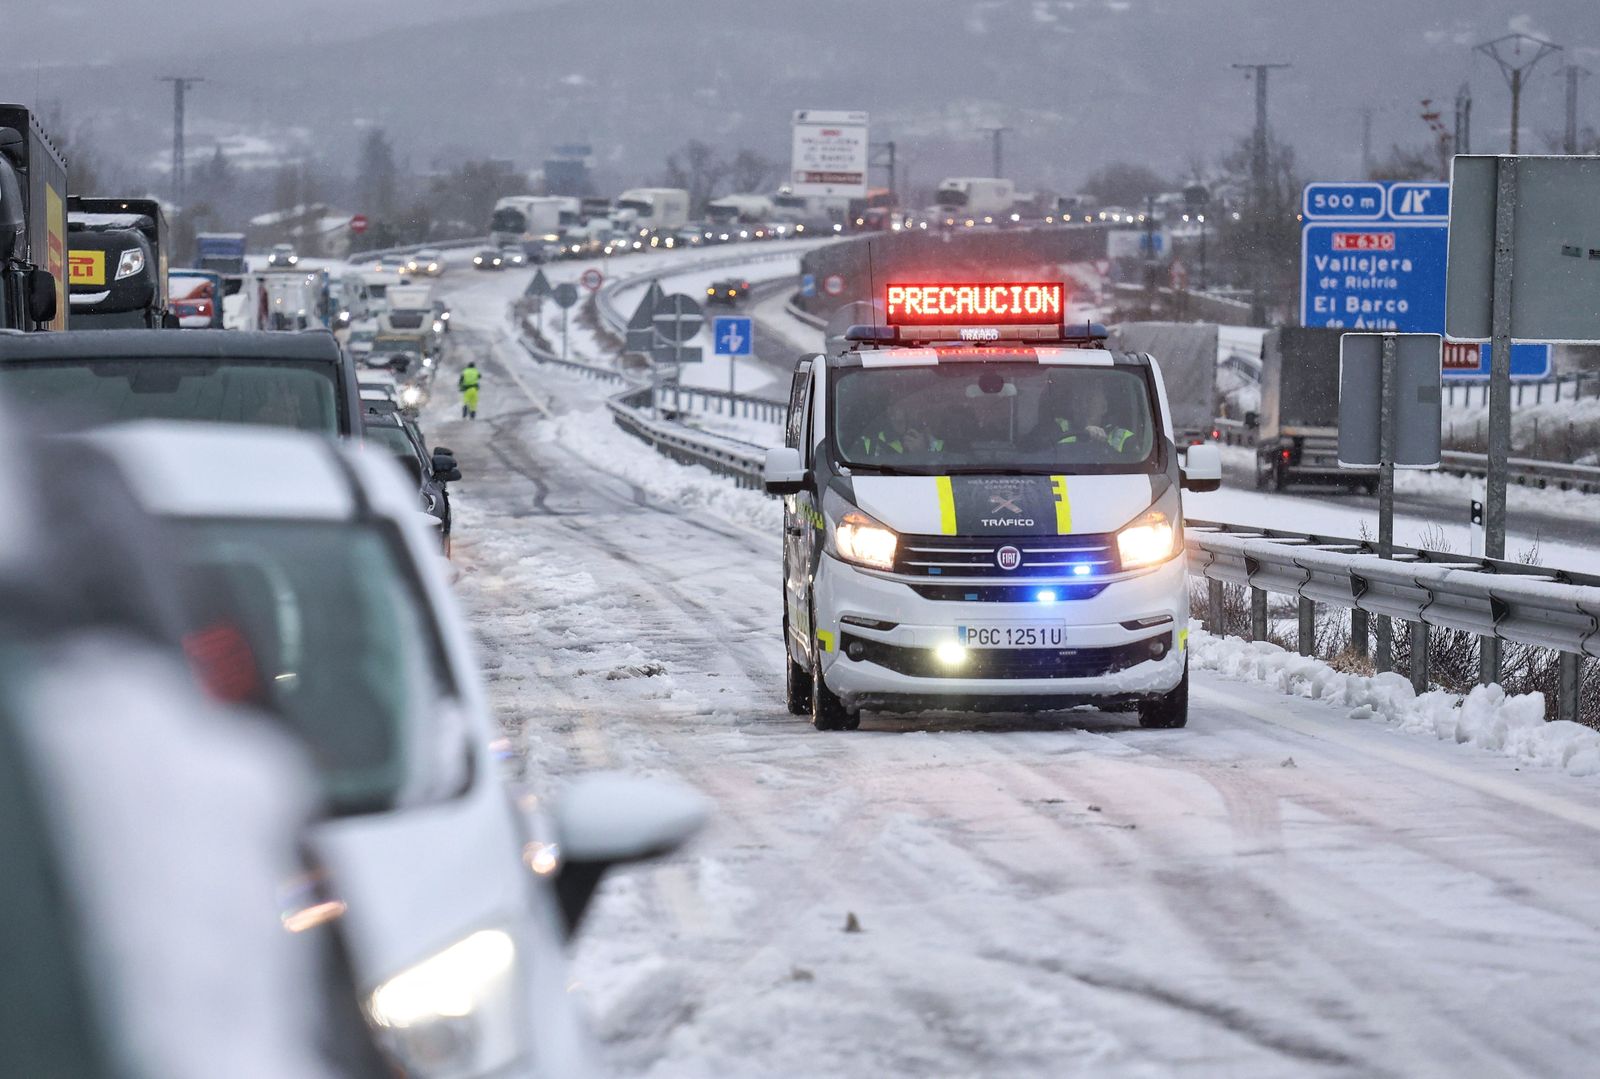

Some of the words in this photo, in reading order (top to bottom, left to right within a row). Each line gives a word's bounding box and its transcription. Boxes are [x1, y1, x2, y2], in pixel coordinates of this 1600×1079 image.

[1314, 194, 1354, 208] 500
[1360, 197, 1375, 208] m
[1333, 234, 1392, 249] N-630
[1314, 255, 1412, 276] Vallejera
[1320, 276, 1338, 289] de
[888, 286, 1060, 315] PRECAUCION
[1314, 296, 1336, 312] El
[1345, 296, 1409, 313] Barco
[1326, 318, 1345, 329] de
[1002, 552, 1016, 565] FIAT
[967, 628, 1001, 645] PGC
